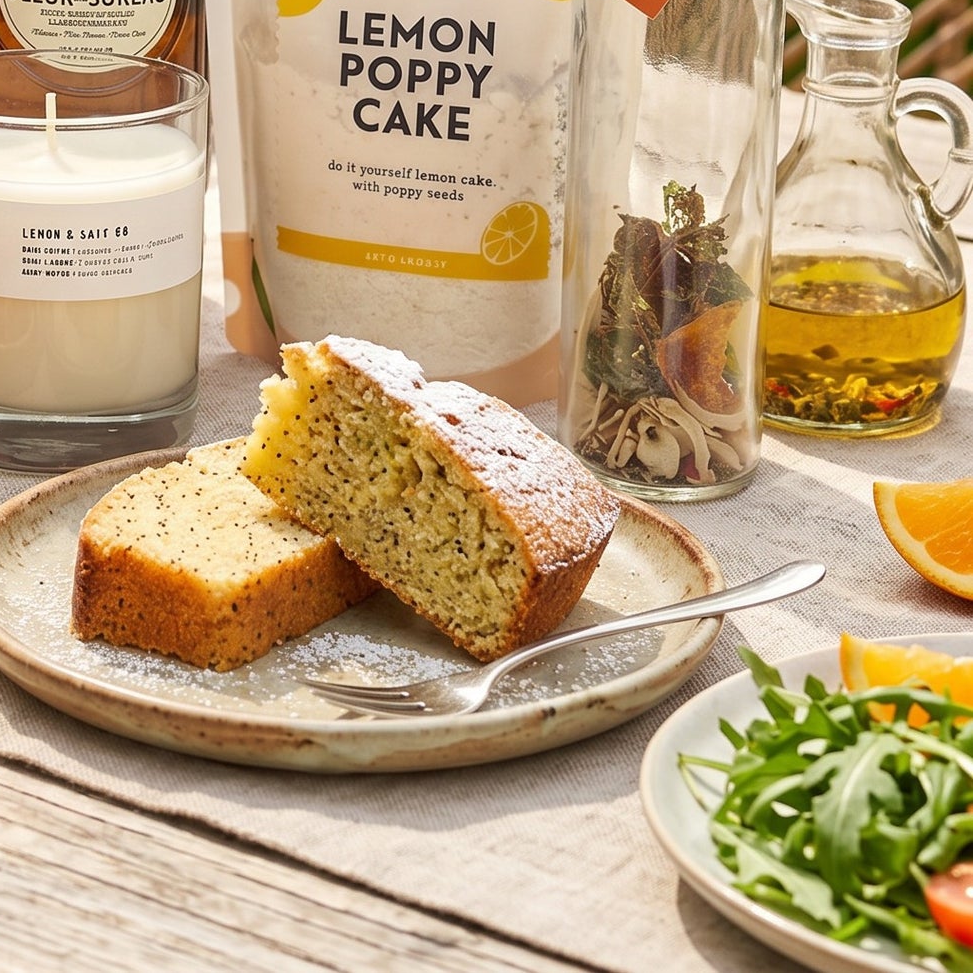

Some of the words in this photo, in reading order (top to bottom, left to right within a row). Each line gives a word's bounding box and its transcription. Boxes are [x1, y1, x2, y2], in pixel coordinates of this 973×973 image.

[338, 10, 497, 57] LEMON
[339, 52, 494, 100] POPPY
[352, 97, 471, 142] CAKE
[328, 159, 343, 172] do
[346, 161, 356, 173] it
[360, 165, 413, 179] yourself
[415, 169, 457, 184] lemon
[460, 174, 497, 187] cake.
[353, 180, 380, 193] with
[384, 185, 423, 200] poppy
[427, 189, 464, 201] seeds
[66, 229, 74, 240] &
